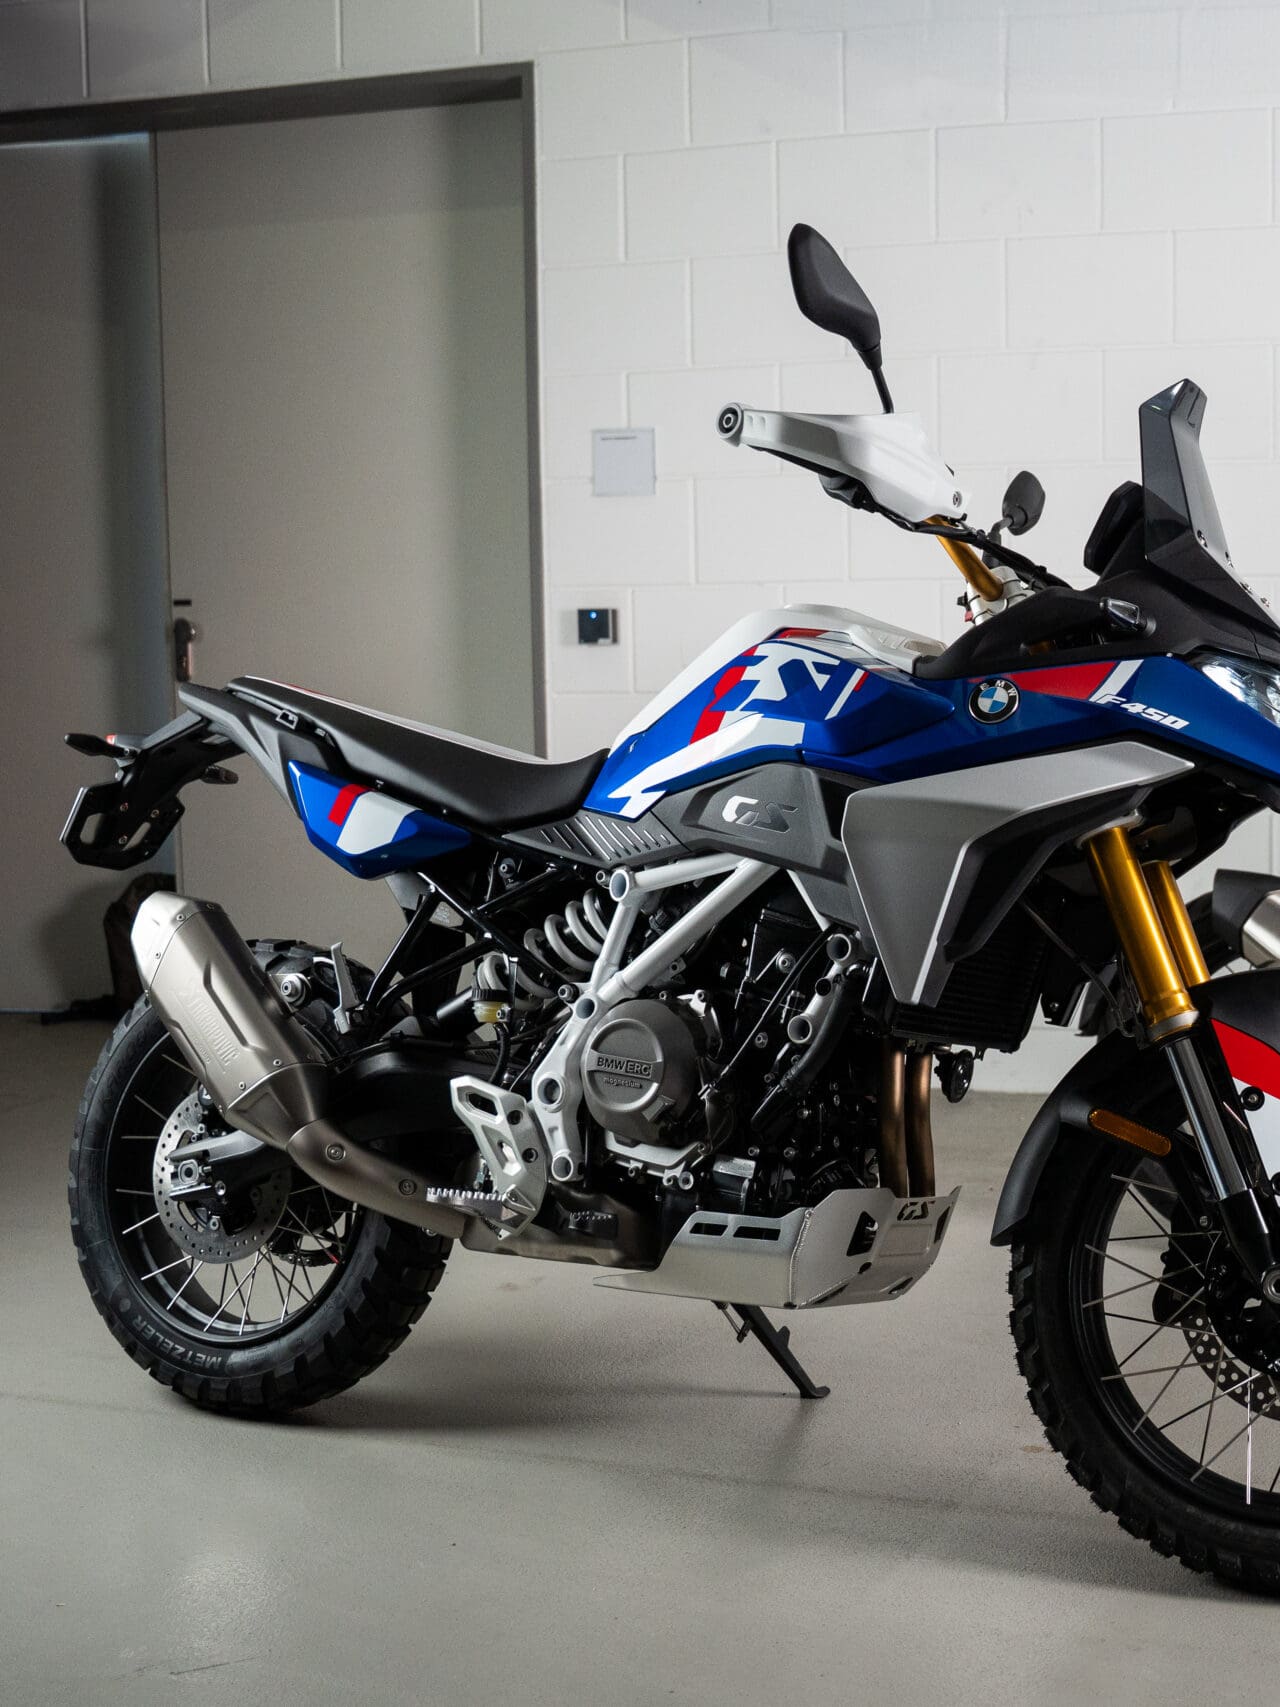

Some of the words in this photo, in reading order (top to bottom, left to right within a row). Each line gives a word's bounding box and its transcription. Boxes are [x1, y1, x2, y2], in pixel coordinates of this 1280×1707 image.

[979, 678, 1018, 698] BMW
[722, 794, 798, 833] GS
[597, 1056, 626, 1072] BMW
[626, 1060, 653, 1078] ERC
[897, 1200, 936, 1221] GS
[131, 1313, 223, 1369] METZELER
